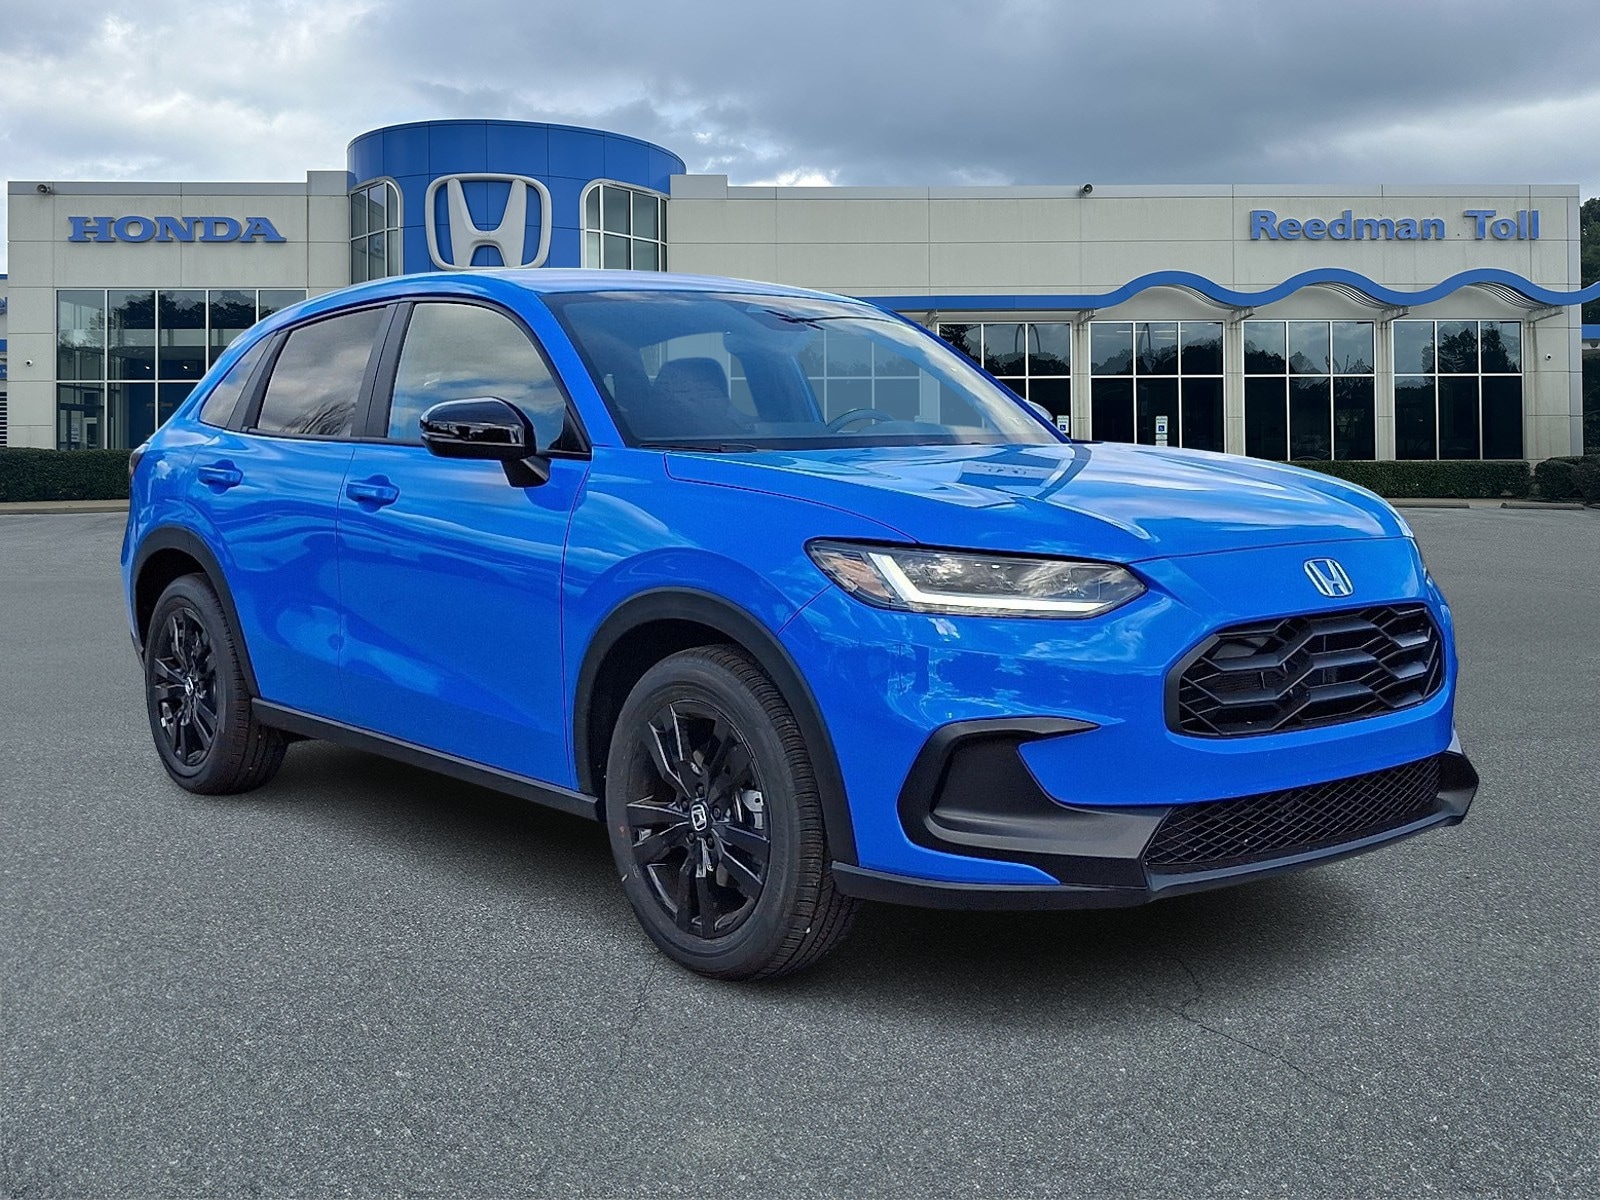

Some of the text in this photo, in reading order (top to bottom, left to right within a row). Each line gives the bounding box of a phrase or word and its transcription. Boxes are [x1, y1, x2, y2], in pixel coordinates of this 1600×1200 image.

[68, 215, 287, 243] HONDA
[1250, 209, 1540, 241] Reedman Toll
